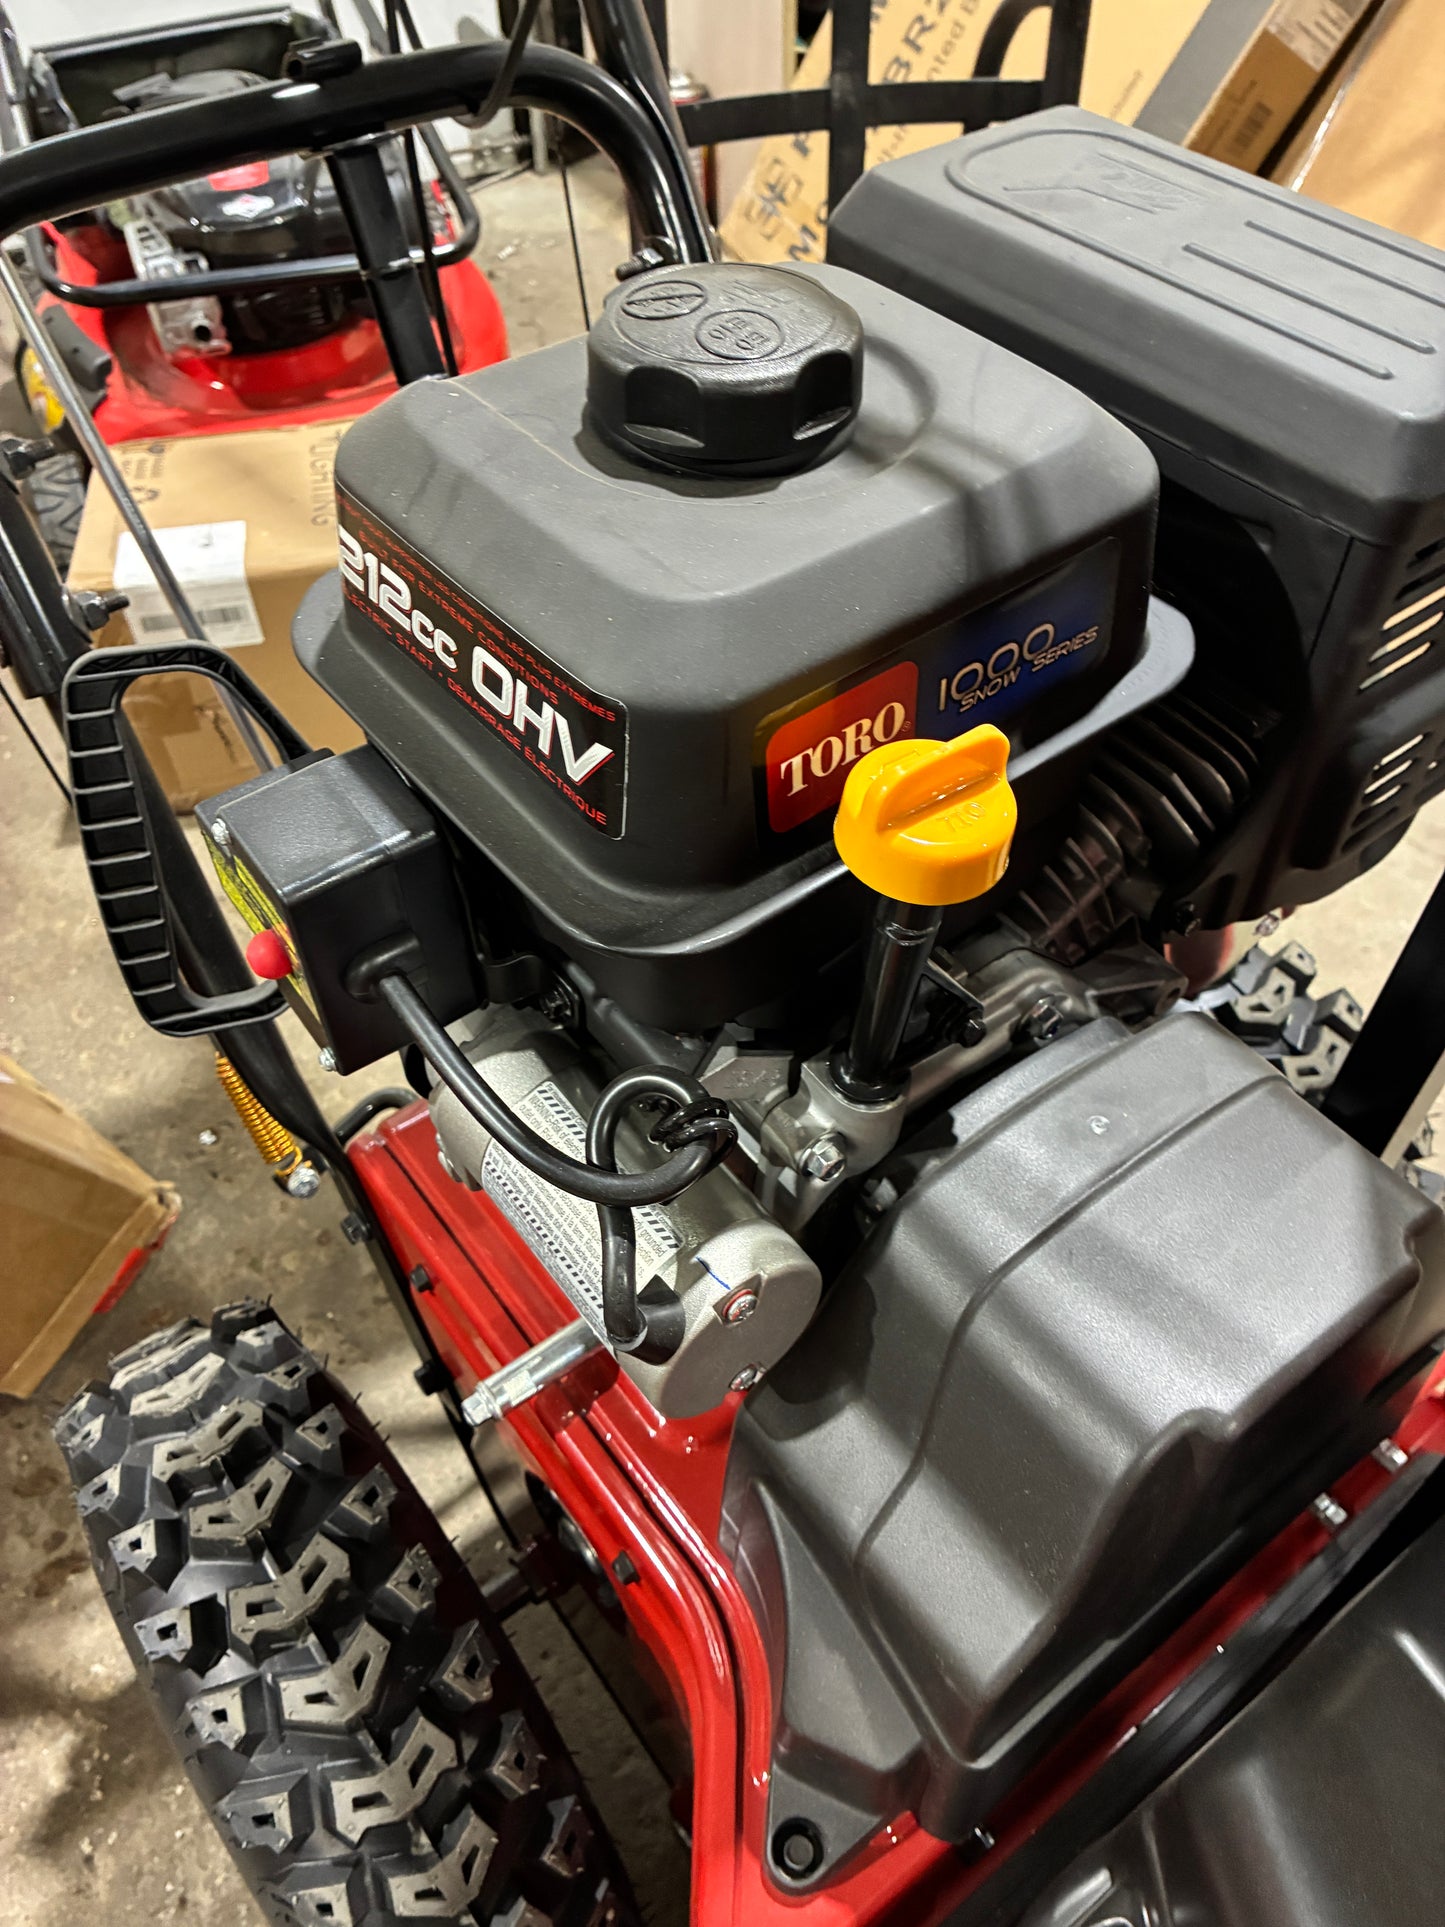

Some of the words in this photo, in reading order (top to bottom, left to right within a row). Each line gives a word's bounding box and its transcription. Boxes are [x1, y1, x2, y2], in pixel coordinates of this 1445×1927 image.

[358, 529, 390, 562] BUILT
[391, 557, 416, 584] FOR
[417, 579, 474, 634] EXTREME
[476, 630, 559, 706] CONDITIONS
[338, 522, 459, 673] 212cc
[471, 645, 616, 786] OHV
[395, 632, 434, 671] START
[525, 652, 552, 681] PLUS
[938, 622, 1056, 712] 1000
[958, 665, 1022, 714] SNOW
[1031, 625, 1099, 673] SERIES
[562, 1135, 584, 1158] electric
[637, 1226, 667, 1259] grounded
